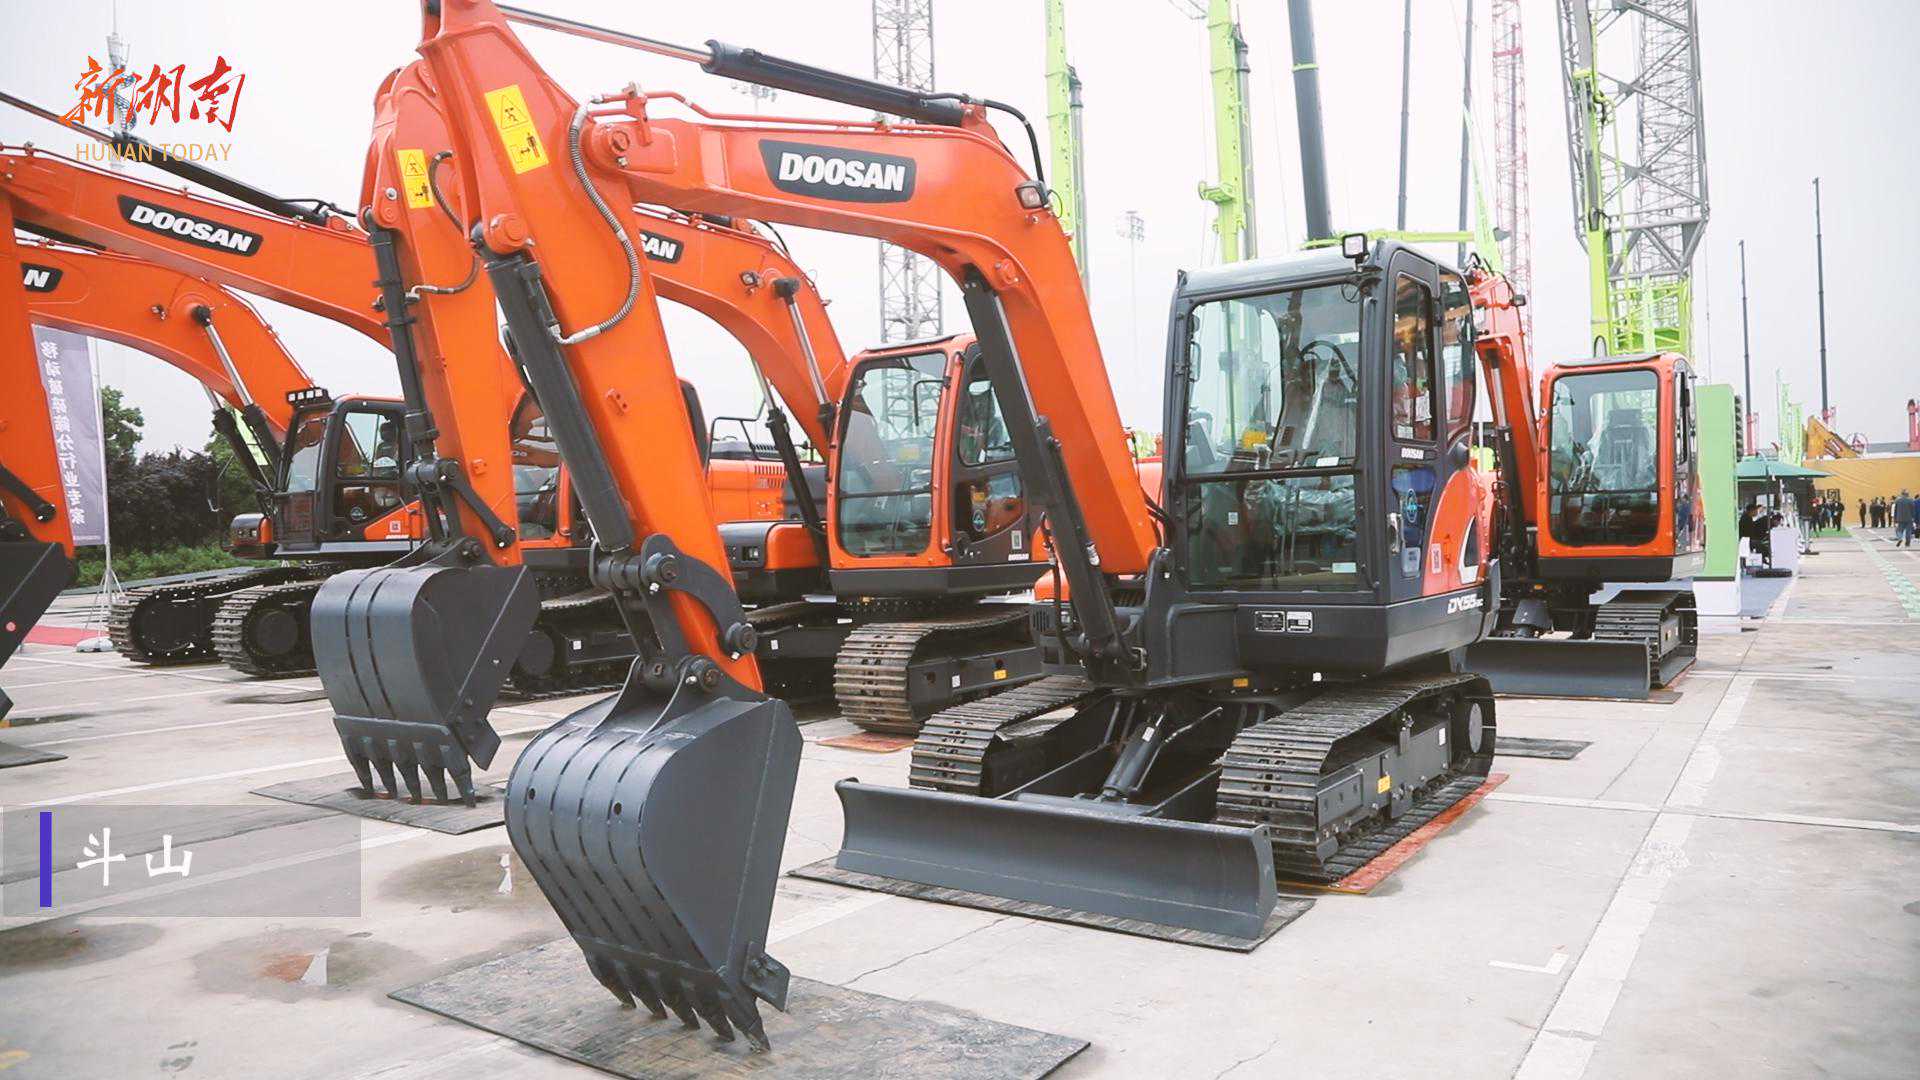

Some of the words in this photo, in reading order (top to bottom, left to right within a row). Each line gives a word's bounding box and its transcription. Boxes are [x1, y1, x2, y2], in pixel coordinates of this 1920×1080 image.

[778, 152, 906, 192] DOOSAN
[130, 204, 253, 252] DOOSAN
[23, 269, 51, 288] N
